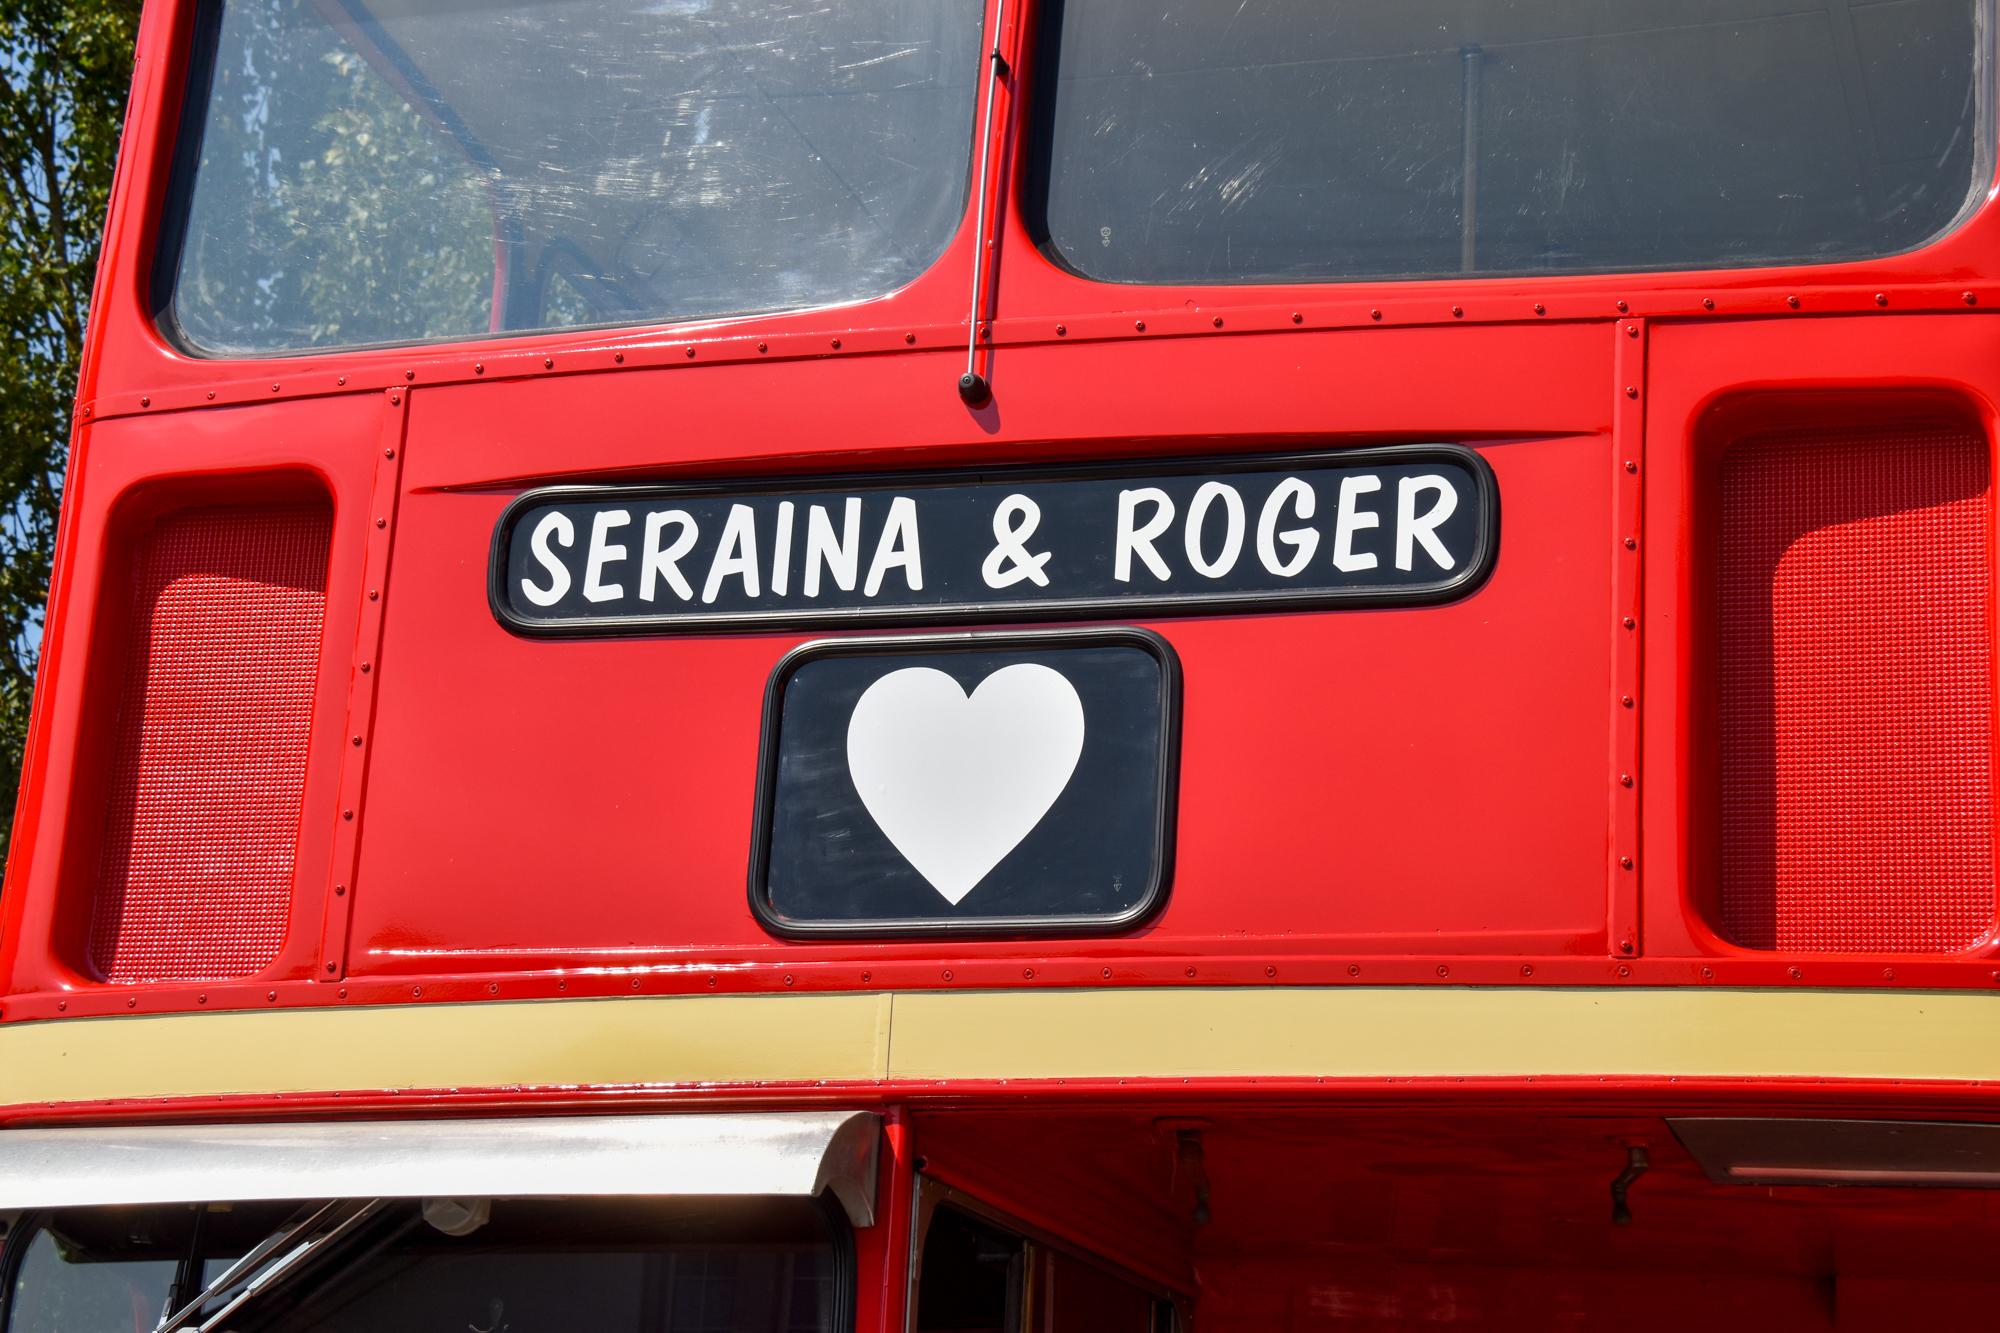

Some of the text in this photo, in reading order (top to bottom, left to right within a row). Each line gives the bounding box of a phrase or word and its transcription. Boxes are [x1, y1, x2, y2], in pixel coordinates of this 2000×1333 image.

[520, 474, 1458, 608] SERAINA & ROGER
